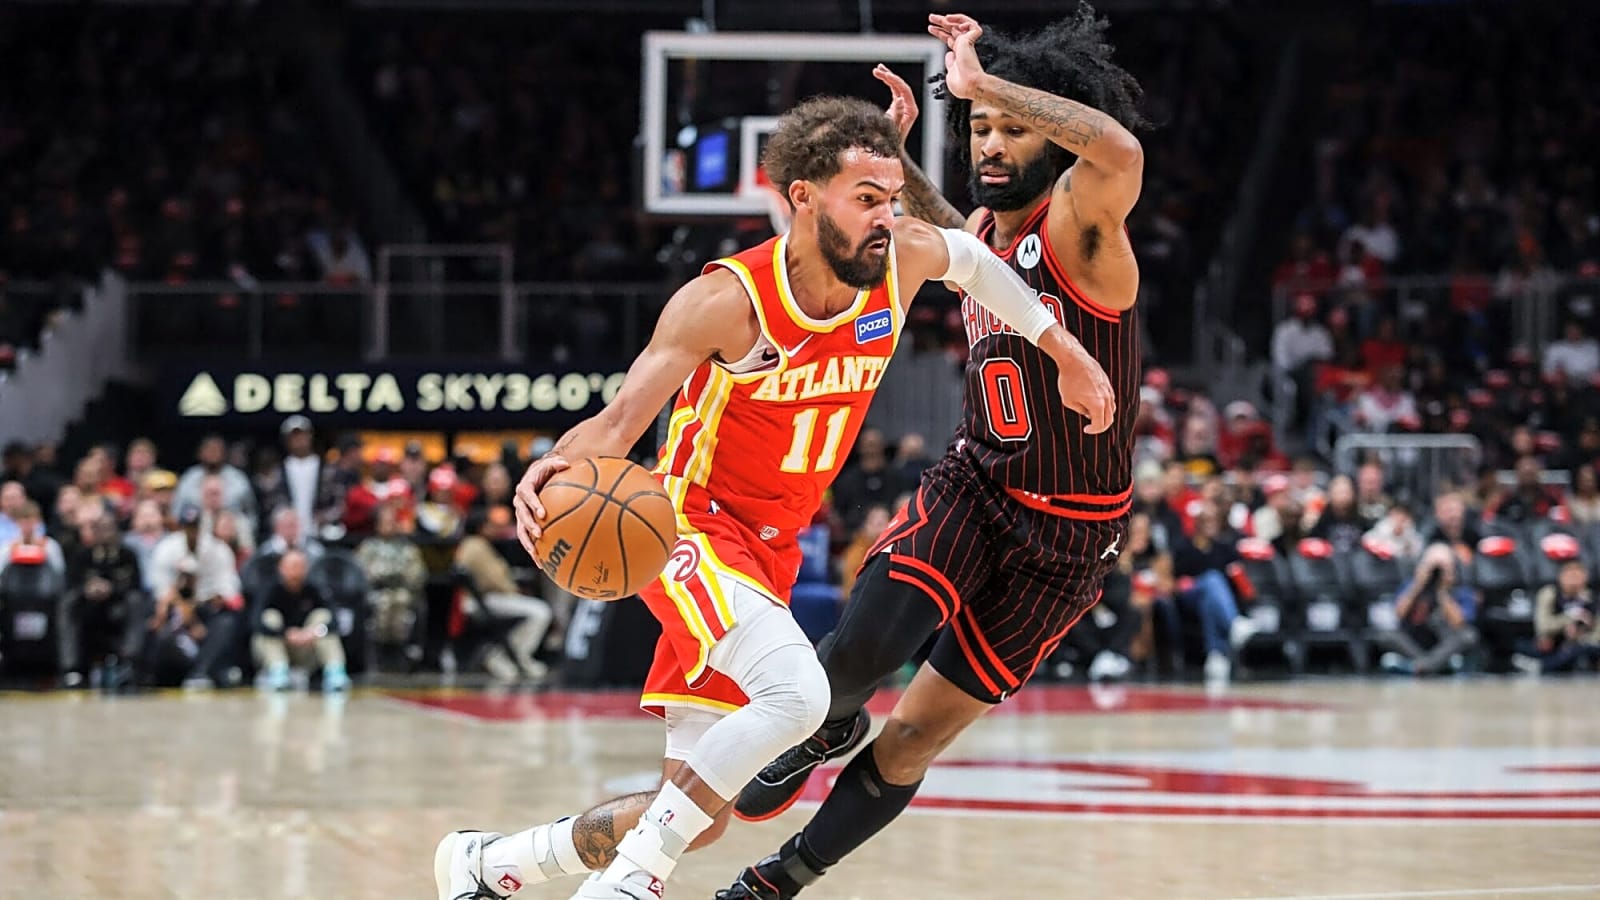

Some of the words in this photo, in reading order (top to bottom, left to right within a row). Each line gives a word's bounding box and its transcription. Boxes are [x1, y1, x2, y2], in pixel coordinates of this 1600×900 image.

[858, 316, 889, 336] paze
[233, 373, 405, 413] DELTA
[750, 356, 892, 402] ATLANT
[979, 357, 1032, 442] 0
[779, 406, 851, 473] 11
